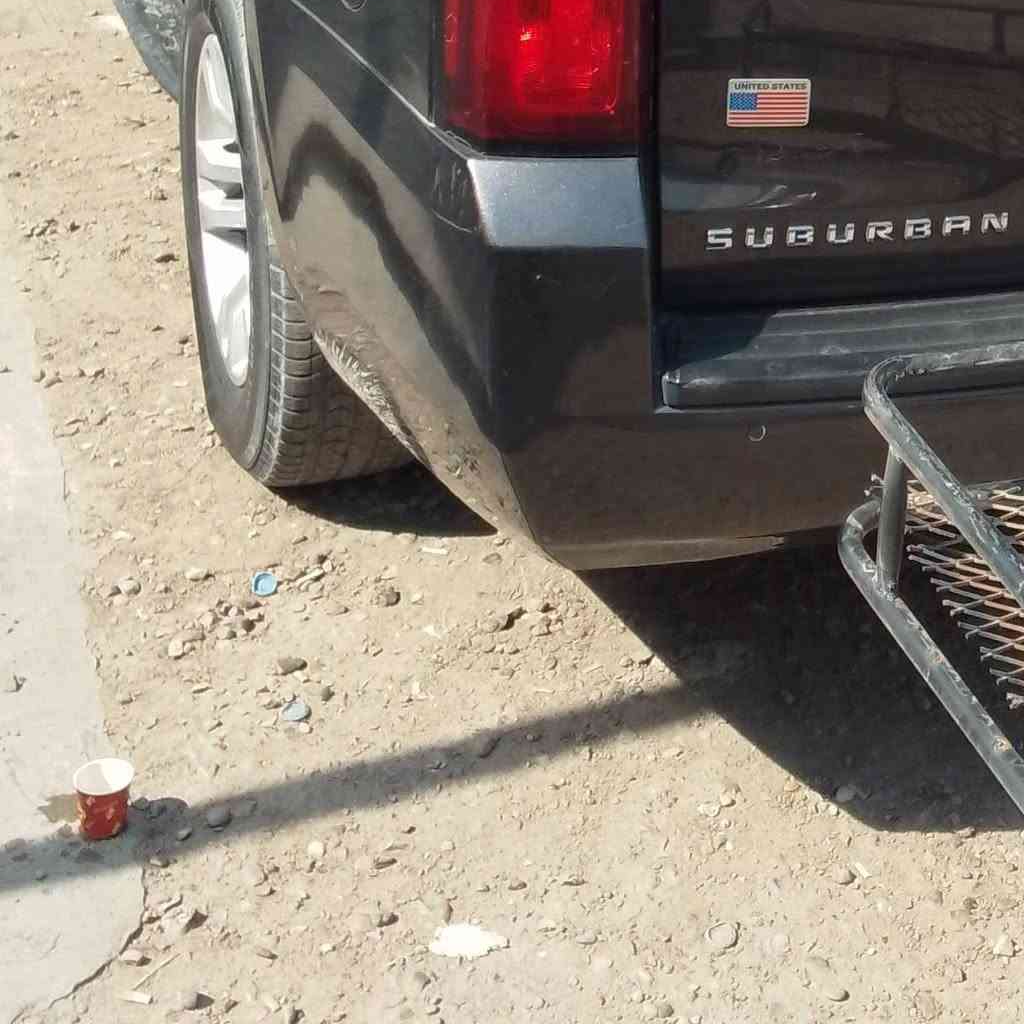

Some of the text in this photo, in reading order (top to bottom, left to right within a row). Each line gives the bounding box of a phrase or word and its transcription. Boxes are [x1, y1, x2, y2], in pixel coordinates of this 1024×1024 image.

[734, 82, 807, 90] UNITED STATES
[706, 211, 1010, 251] SUBURBAN
